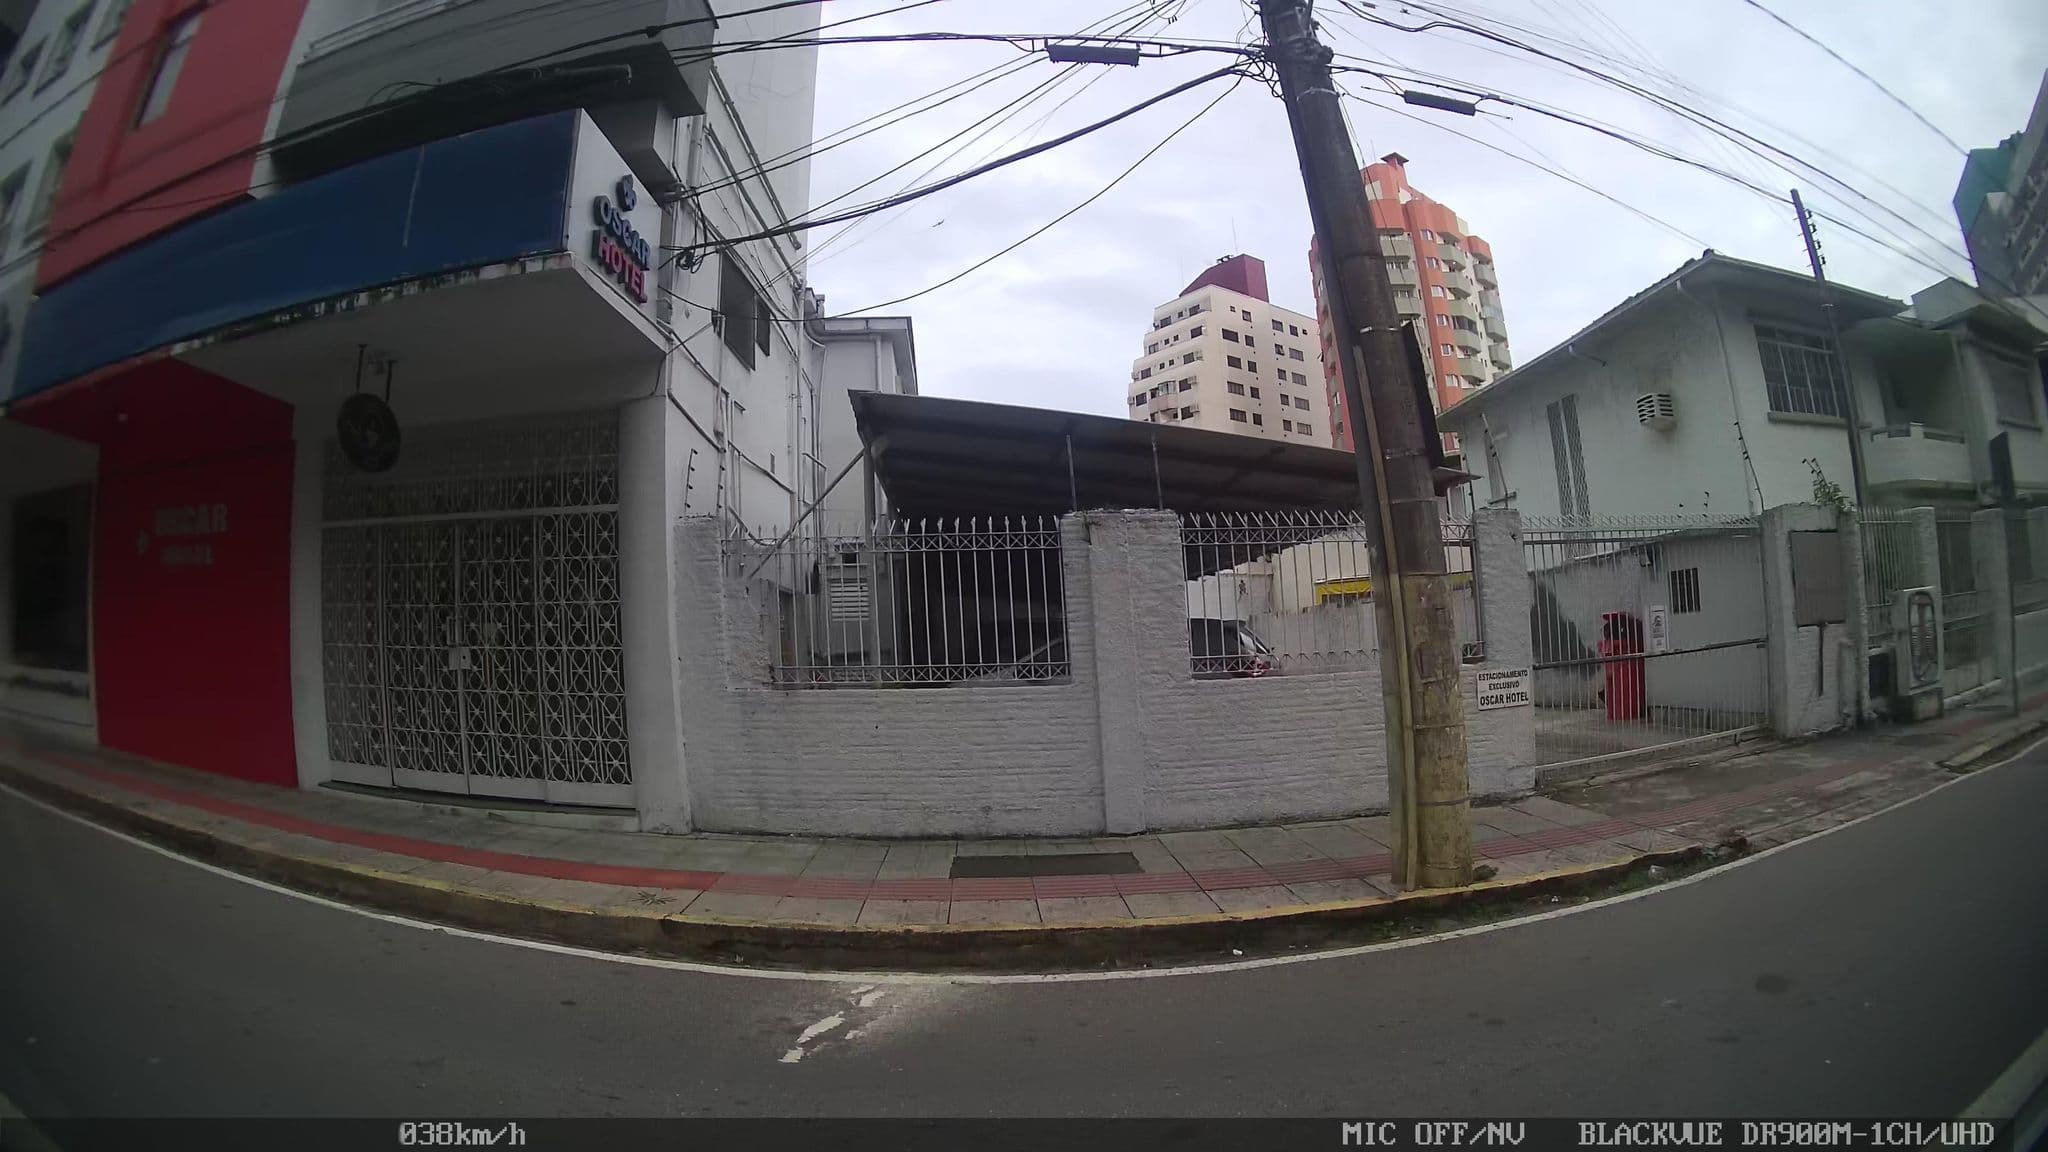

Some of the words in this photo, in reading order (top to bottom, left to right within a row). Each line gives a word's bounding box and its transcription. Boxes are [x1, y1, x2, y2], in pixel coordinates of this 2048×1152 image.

[593, 195, 650, 271] OSCAR
[592, 229, 648, 303] HOTEL
[1478, 669, 1529, 681] ESTACIONAMENTO
[1488, 680, 1520, 691] EXCLUSIVO
[1480, 694, 1505, 706] OSCAR
[1505, 691, 1529, 704] HOTEL
